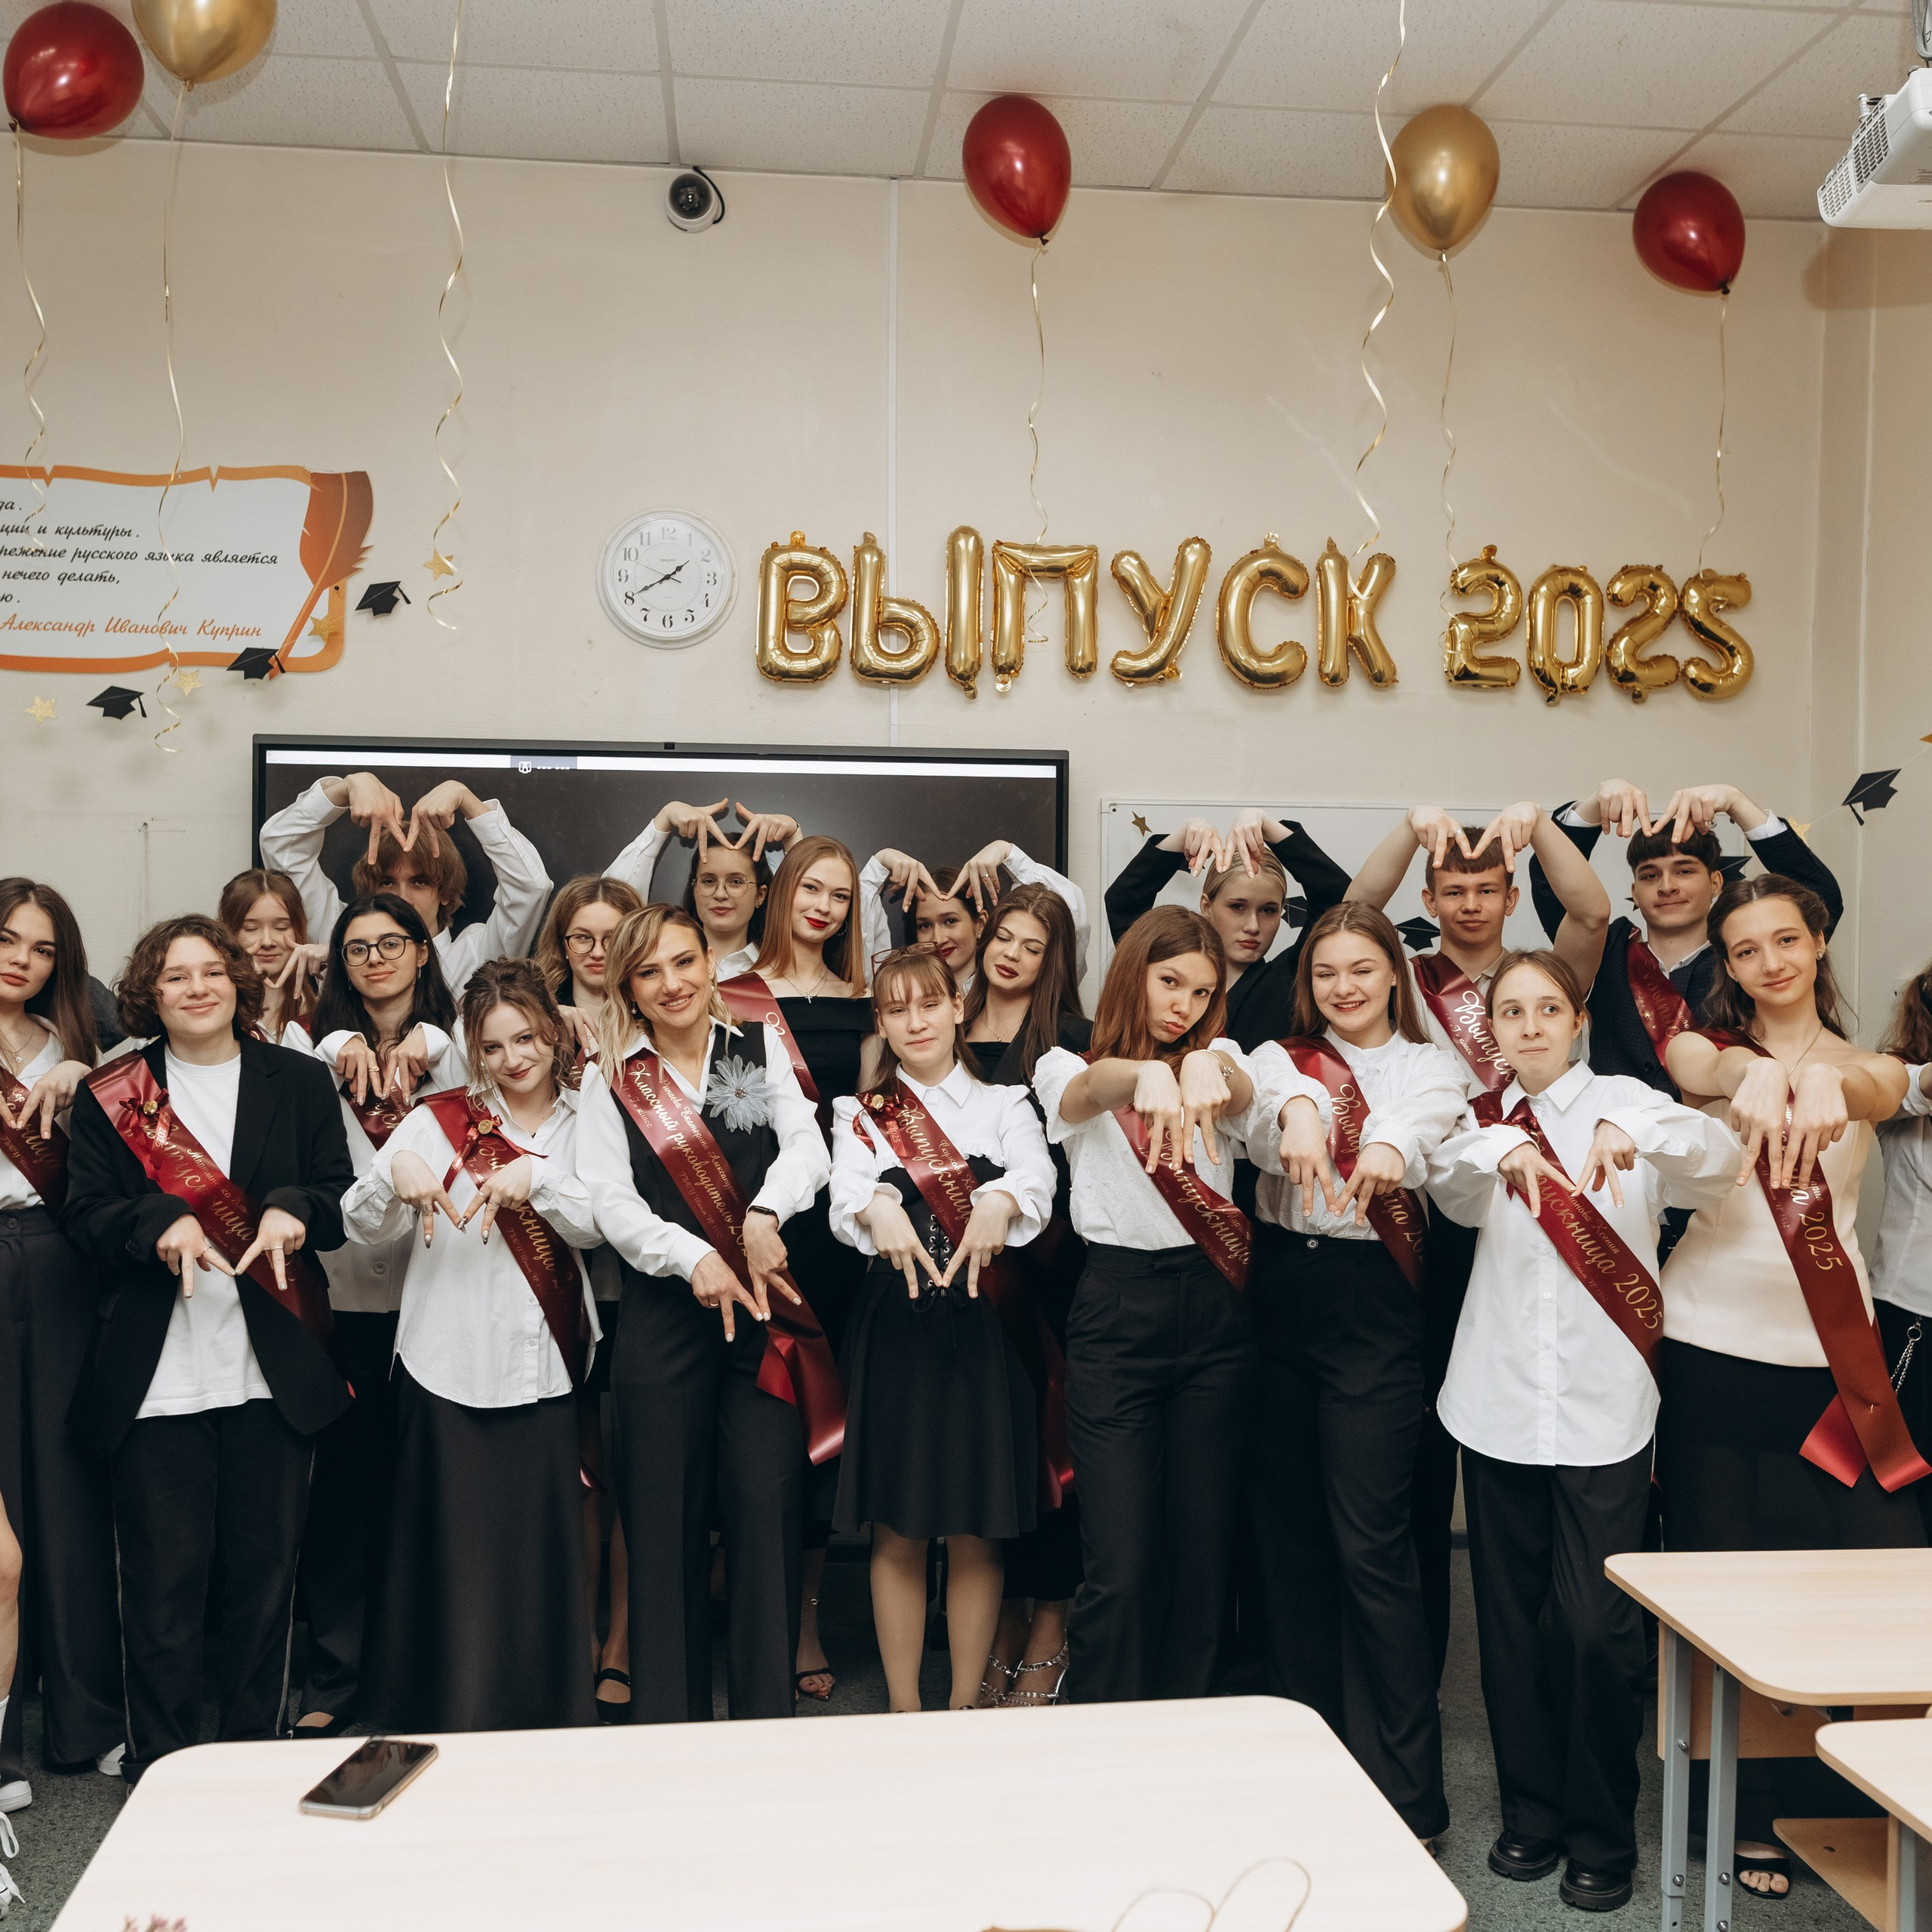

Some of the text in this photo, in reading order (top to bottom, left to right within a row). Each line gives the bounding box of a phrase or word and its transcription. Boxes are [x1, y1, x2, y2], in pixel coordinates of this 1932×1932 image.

[38, 525, 47, 534] и
[55, 525, 139, 541] культуры.
[638, 531, 651, 546] 11
[660, 526, 676, 540] 12
[687, 533, 692, 547] 1
[71, 547, 137, 563] русского
[201, 550, 278, 564] является
[623, 547, 639, 561] 10
[700, 549, 711, 563] 2
[2, 571, 120, 586] нечего делать,
[618, 569, 629, 583] 9
[706, 571, 717, 586] 3
[624, 591, 635, 605] 8
[700, 593, 709, 607] 4
[641, 608, 651, 622] 7
[662, 614, 673, 629] 6
[685, 609, 694, 623] 5
[755, 525, 1755, 706] ВЫПУСК 2025
[0, 614, 261, 641] Александр Иванович Куприн
[628, 1062, 677, 1133] Классный
[666, 1131, 734, 1223] руководитель
[896, 1098, 972, 1225] Выпускниц
[1799, 1212, 1843, 1272] 2025
[1614, 1273, 1663, 1330] 2025
